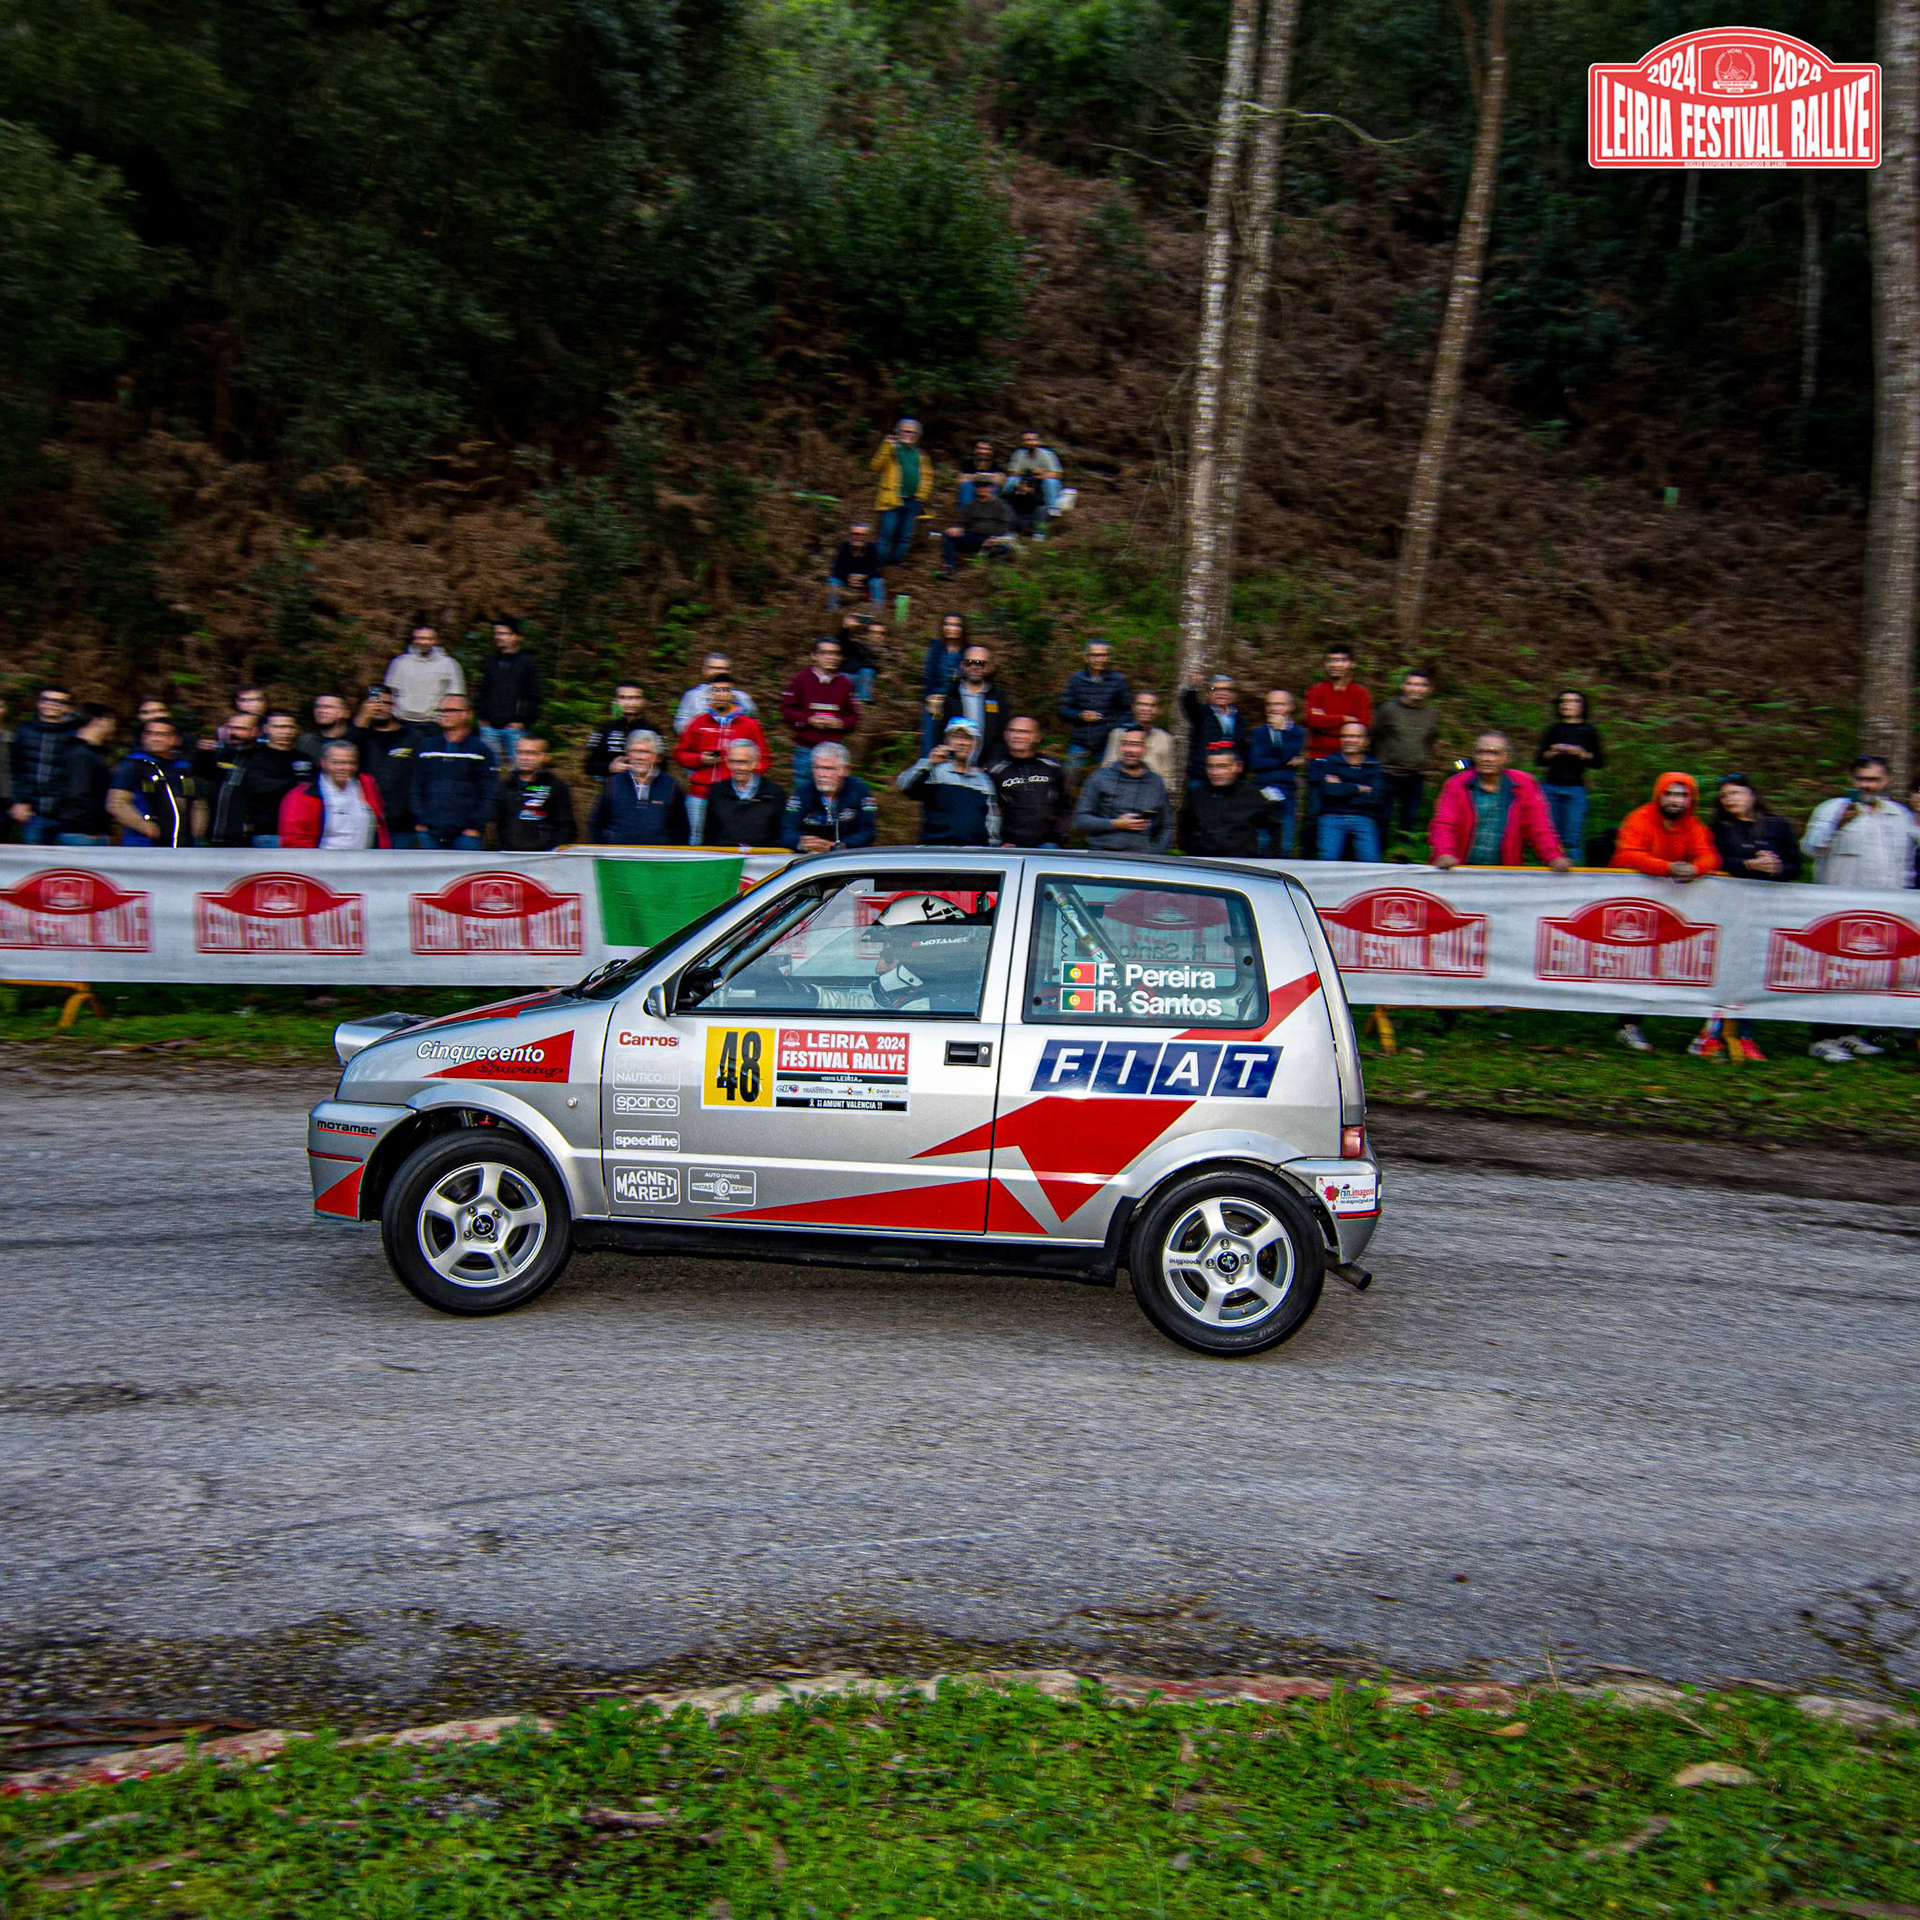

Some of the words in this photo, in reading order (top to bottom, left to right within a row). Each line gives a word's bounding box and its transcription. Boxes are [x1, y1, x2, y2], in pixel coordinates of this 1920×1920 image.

[1098, 963, 1117, 985] F.
[1125, 964, 1216, 988] Pereira
[1097, 990, 1123, 1013] R.
[1130, 990, 1223, 1016] Santos
[618, 1031, 678, 1047] Carros
[807, 1032, 869, 1050] LEIRIA
[876, 1035, 906, 1050] 2024
[416, 1040, 546, 1063] Cinquecento
[781, 1050, 850, 1071] FESTIVAL
[853, 1053, 906, 1072] RALLYE
[717, 1030, 763, 1103] 48
[1050, 1047, 1269, 1089] FIAT
[616, 1096, 677, 1112] sparco
[846, 1101, 876, 1109] VALENCIA
[615, 1134, 678, 1147] speedline
